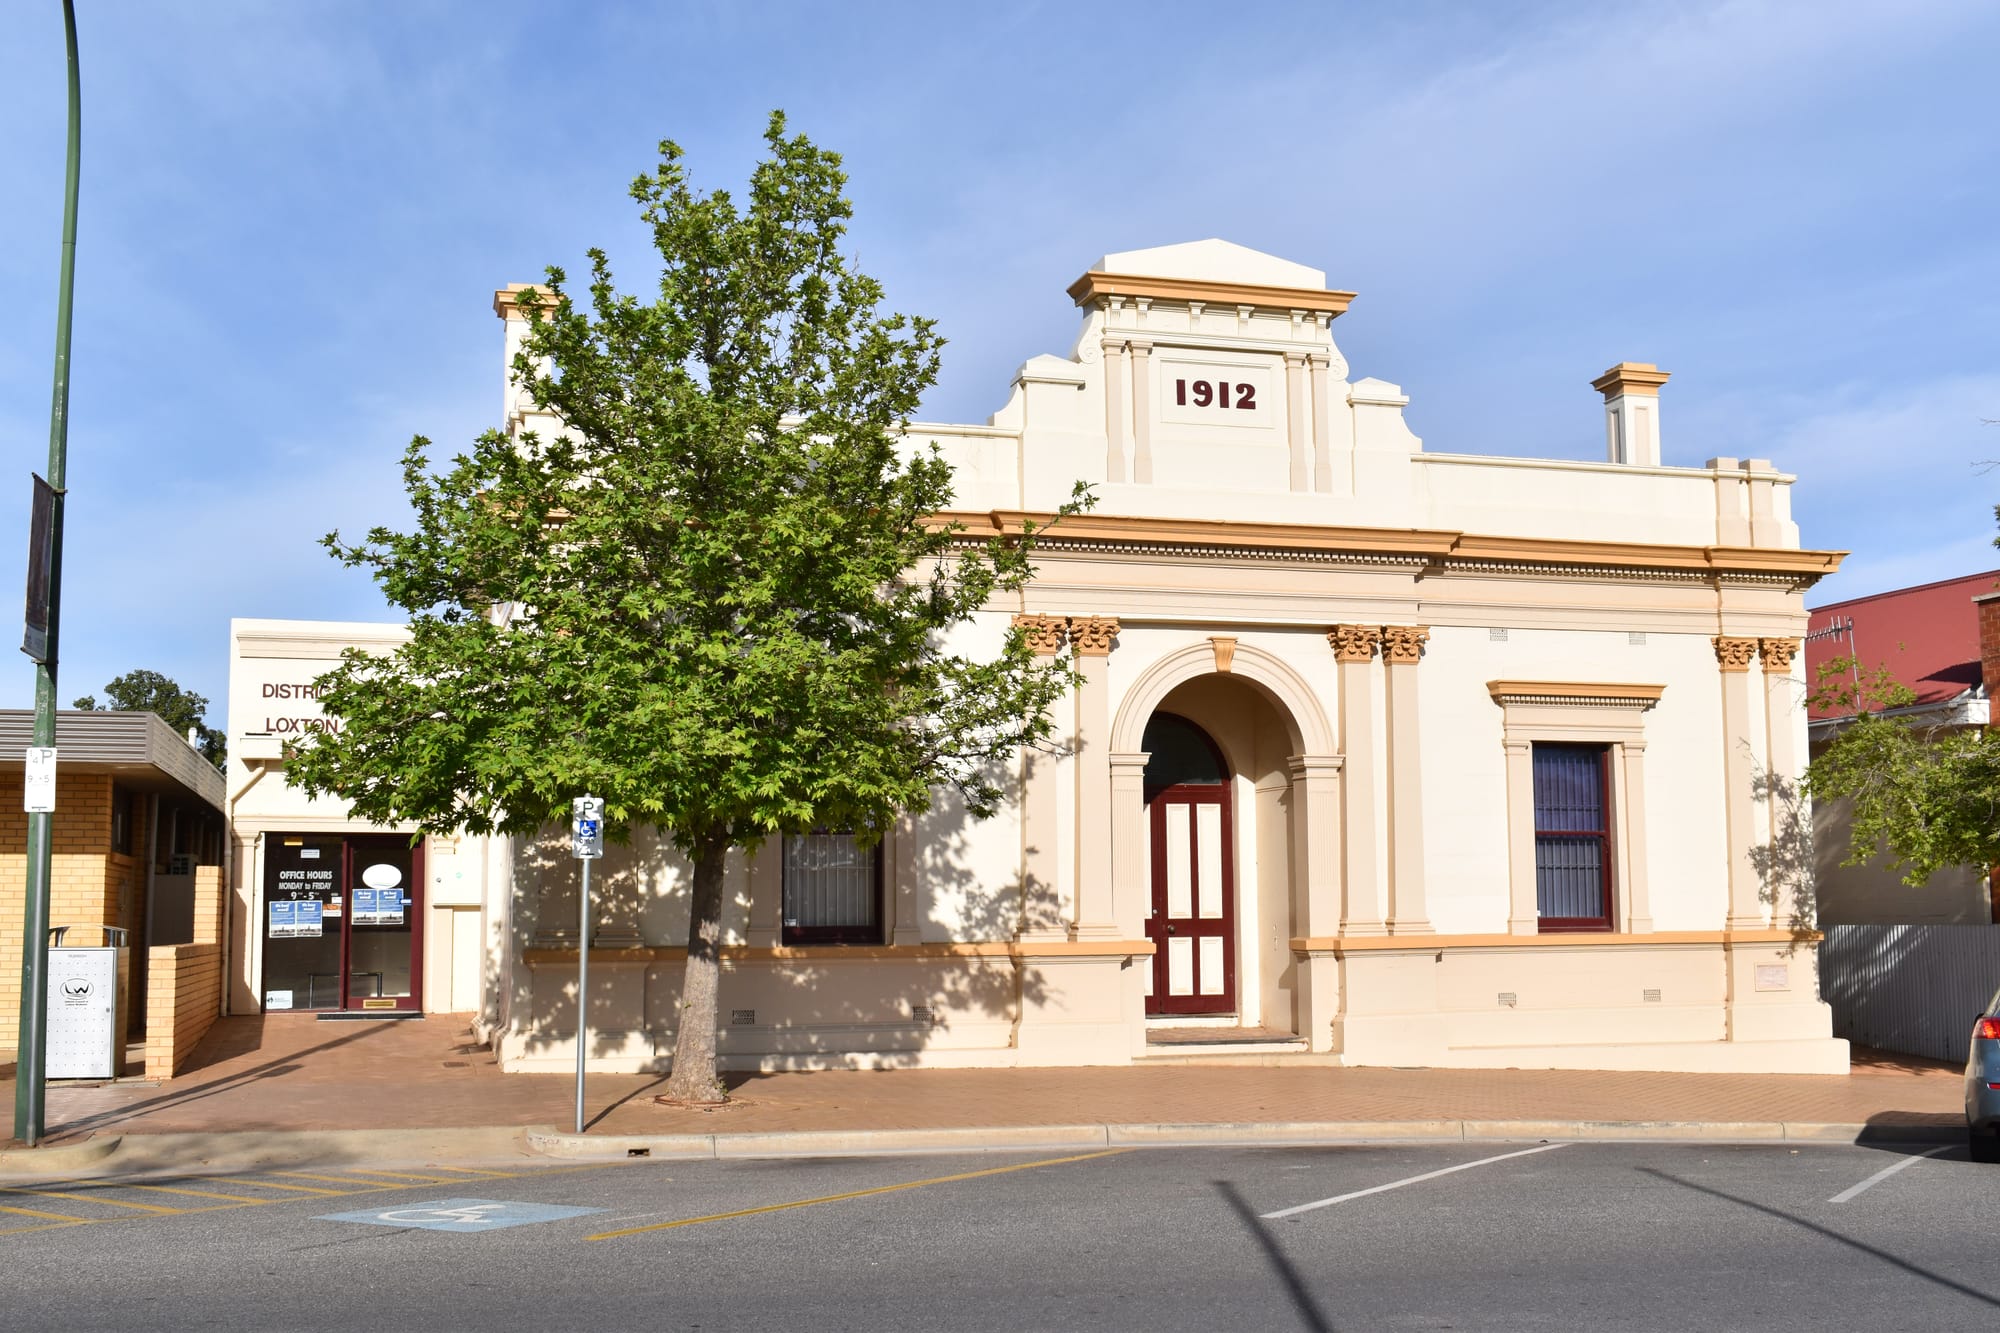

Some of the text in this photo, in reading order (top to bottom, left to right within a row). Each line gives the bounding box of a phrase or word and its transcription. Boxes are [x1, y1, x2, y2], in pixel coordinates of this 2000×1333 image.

[1176, 379, 1256, 410] 1912
[266, 717, 338, 733] LOXTON
[40, 749, 53, 765] P
[583, 802, 594, 815] P
[280, 871, 333, 880] OFFICE HOURS
[278, 882, 303, 890] MONDAY
[312, 882, 332, 890] FRIDAY
